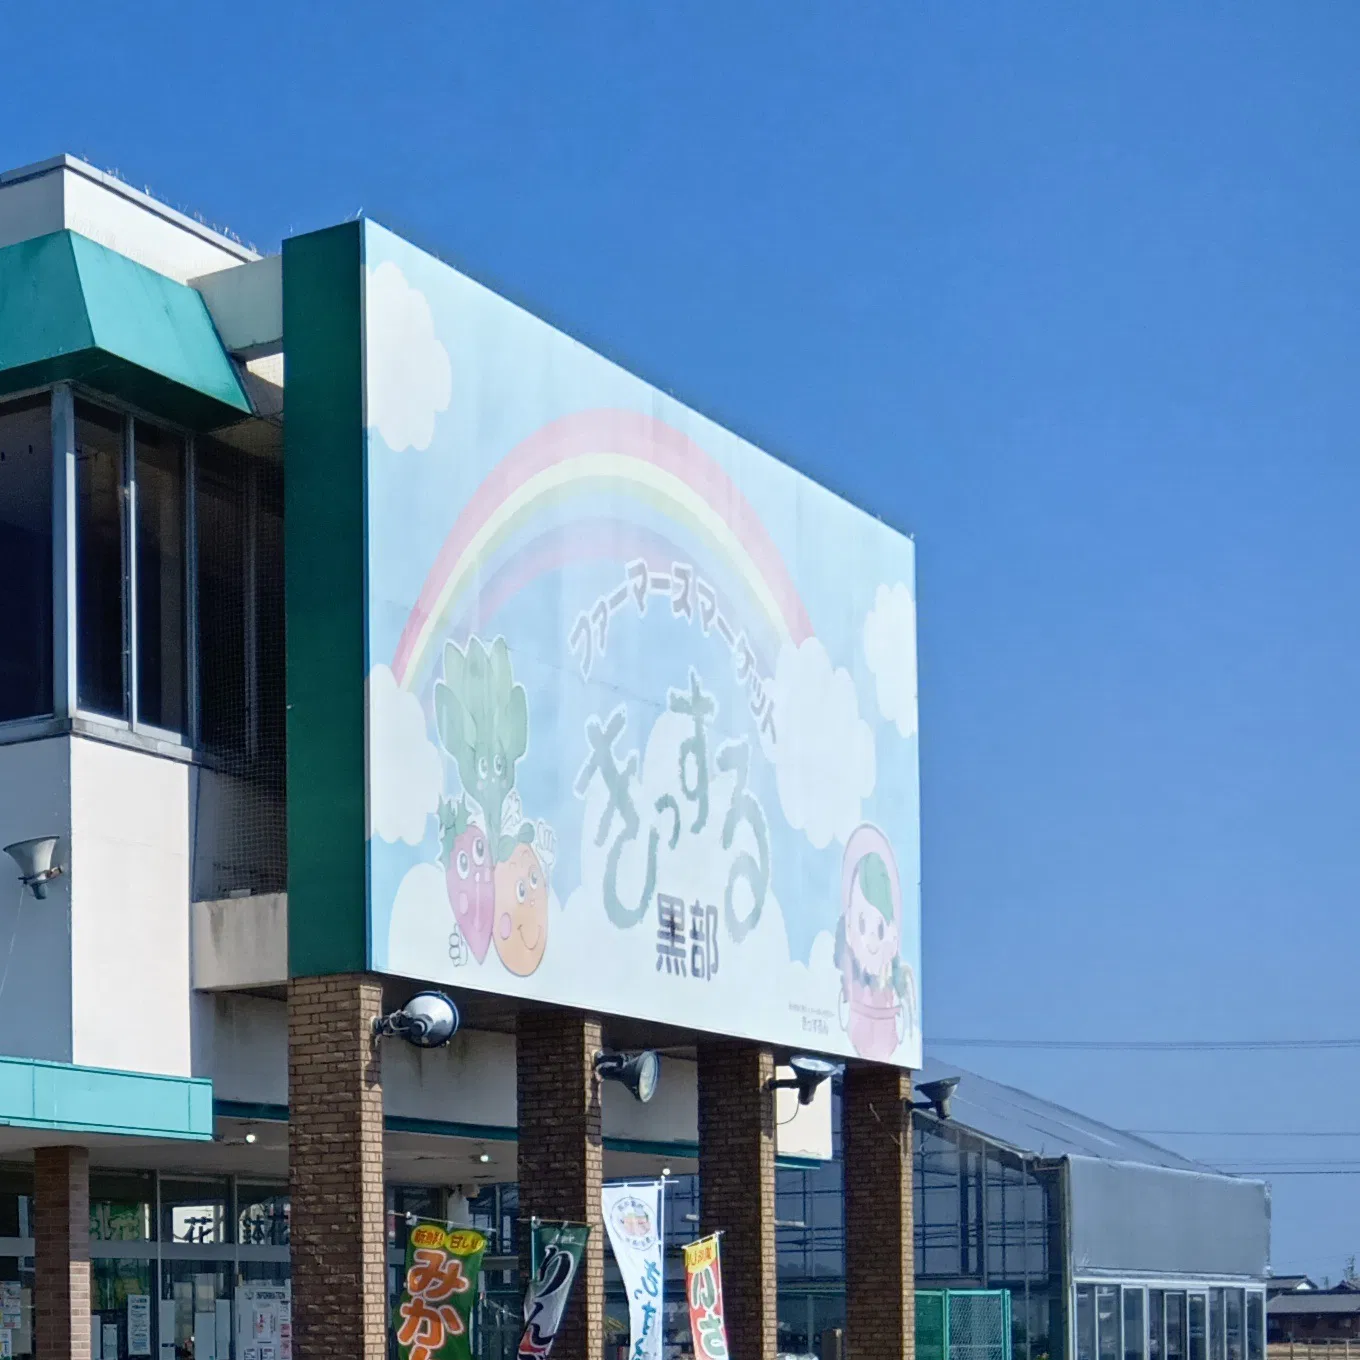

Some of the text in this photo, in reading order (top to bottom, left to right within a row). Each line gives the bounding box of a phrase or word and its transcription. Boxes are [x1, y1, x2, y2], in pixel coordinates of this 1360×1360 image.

[575, 664, 770, 943] きっする
[655, 893, 720, 982] 黒部
